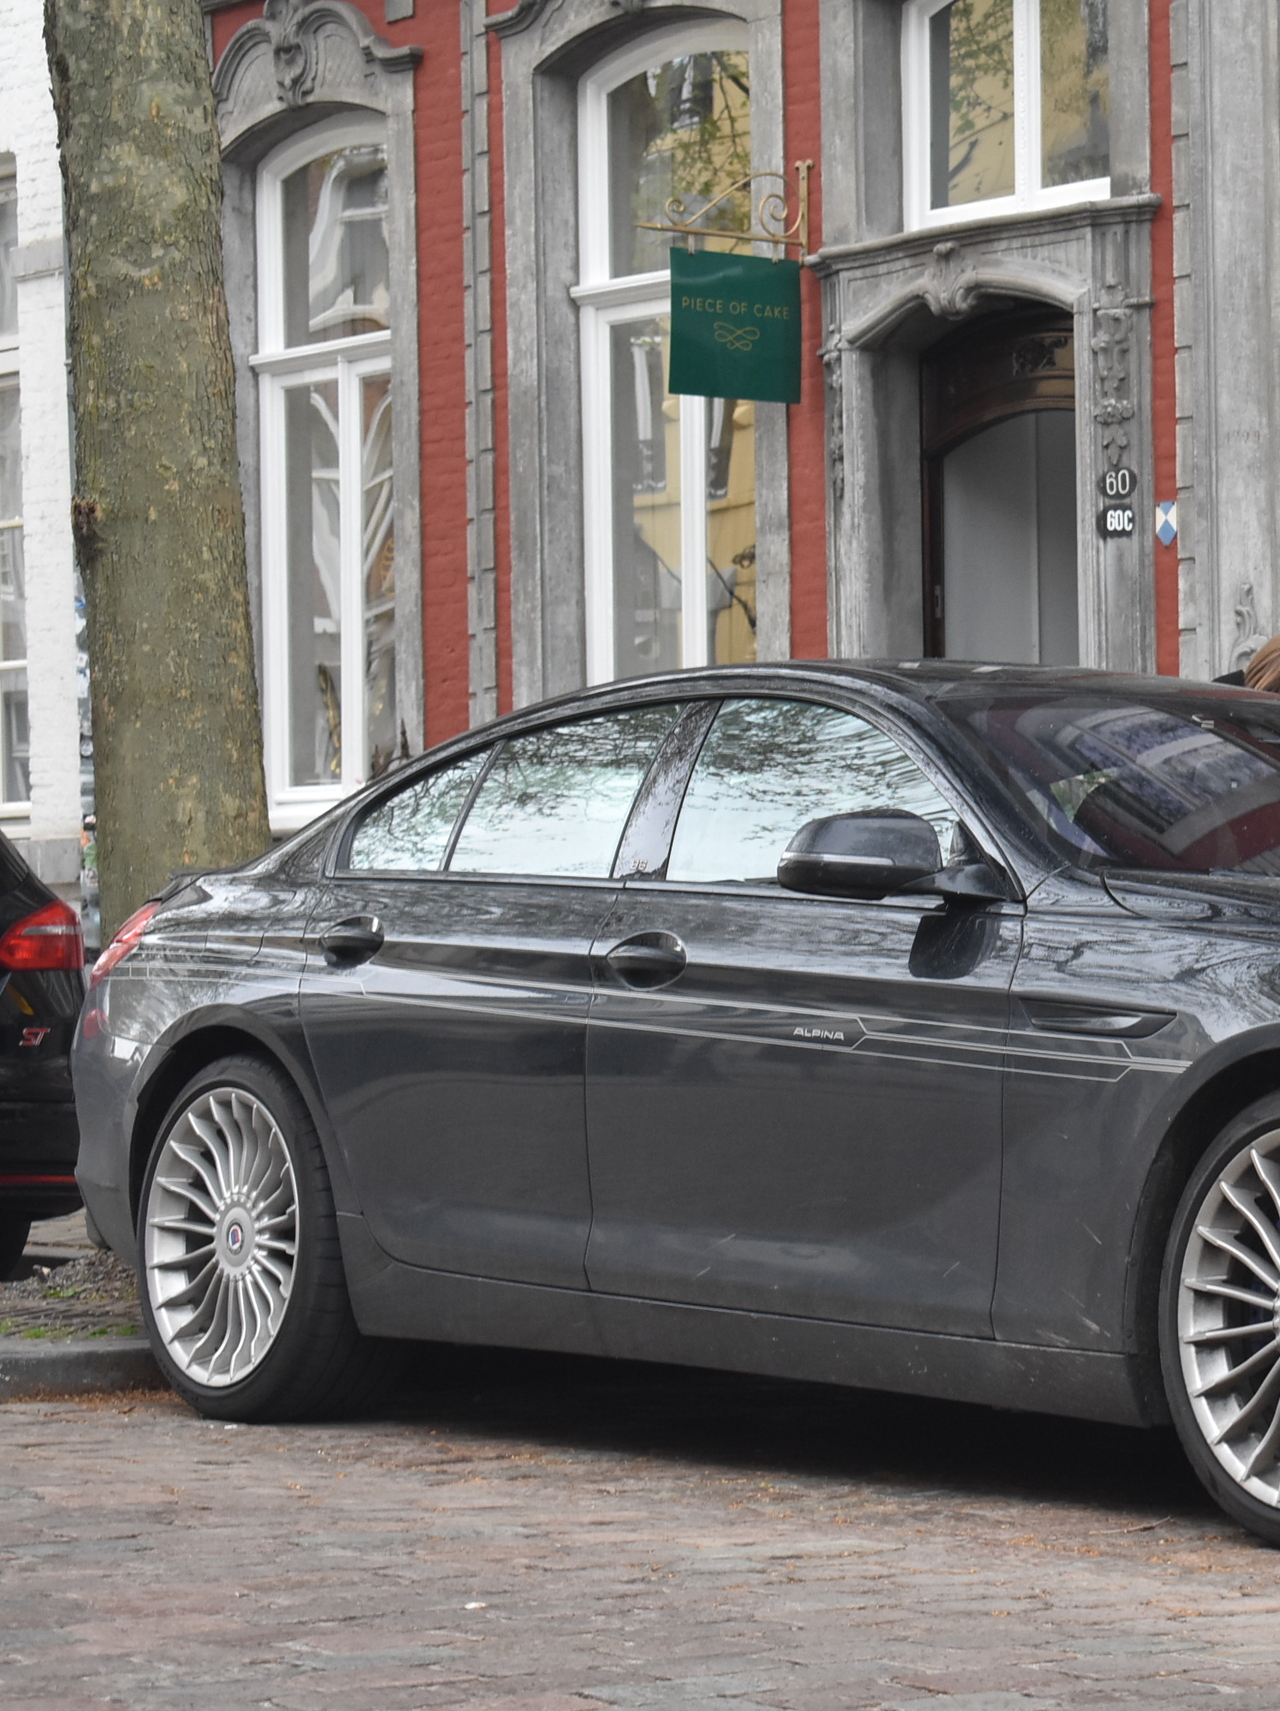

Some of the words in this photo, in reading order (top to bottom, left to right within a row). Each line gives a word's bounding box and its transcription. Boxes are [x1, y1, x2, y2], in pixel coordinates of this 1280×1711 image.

[682, 296, 723, 313] PIECE
[729, 301, 748, 315] OF
[753, 304, 791, 320] CAKE
[1105, 469, 1130, 496] 60
[1106, 509, 1133, 532] 60C
[19, 1027, 51, 1046] ST
[793, 1026, 845, 1041] ALPINA
